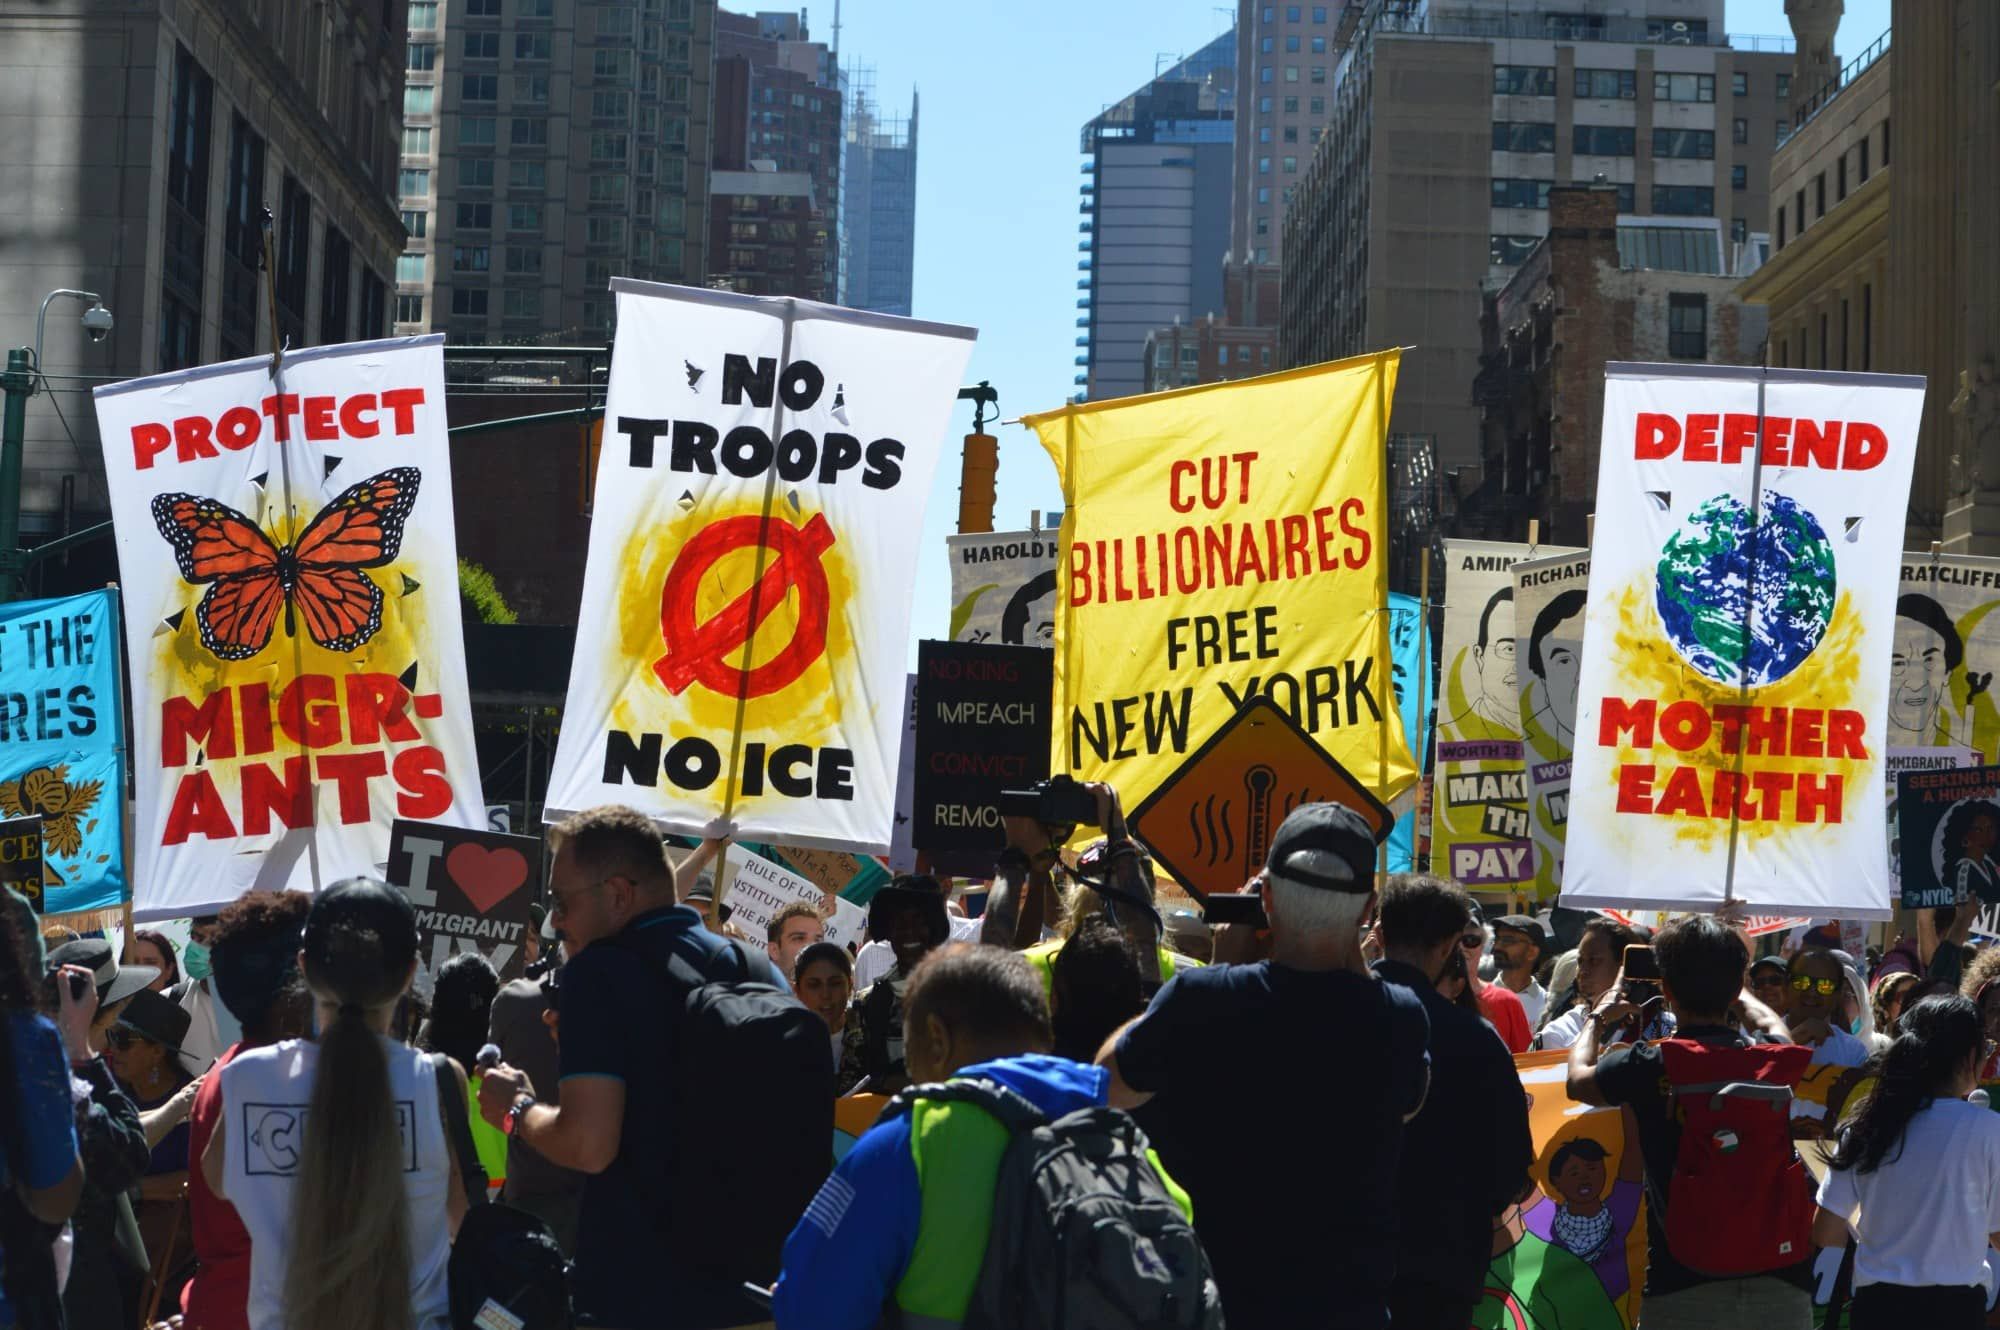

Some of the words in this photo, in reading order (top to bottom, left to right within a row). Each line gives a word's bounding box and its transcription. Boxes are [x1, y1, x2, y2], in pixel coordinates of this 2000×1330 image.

[721, 353, 825, 411] NO
[131, 388, 425, 470] PROTECT
[617, 416, 906, 490] TROOPS
[1634, 413, 1888, 471] DEFEND
[1169, 451, 1258, 513] CUT
[963, 542, 1044, 564] HAROLD
[1071, 498, 1371, 607] BILLIONAIRES
[1521, 561, 1590, 588] RICHAR
[19, 614, 94, 669] THE
[1167, 606, 1279, 670] FREE
[162, 673, 442, 768] MIGR-
[937, 702, 1035, 724] IMPEACH
[1072, 687, 1193, 770] NEW
[1598, 697, 1869, 760] MOTHER
[602, 730, 721, 790] NO
[741, 743, 854, 801] ICE
[930, 752, 1027, 777] CONVICT
[1443, 745, 1498, 758] WORTH
[1887, 756, 1956, 769] MMIGRANTS
[1908, 770, 1980, 789] SEEKING
[162, 746, 453, 846] ANTS
[1616, 764, 1843, 824] EARTH
[400, 836, 444, 907] I
[745, 859, 777, 882] RULE
[778, 877, 798, 891] OF
[1455, 848, 1527, 878] PAY
[415, 910, 524, 941] MIGRANT
[731, 902, 756, 921] THE
